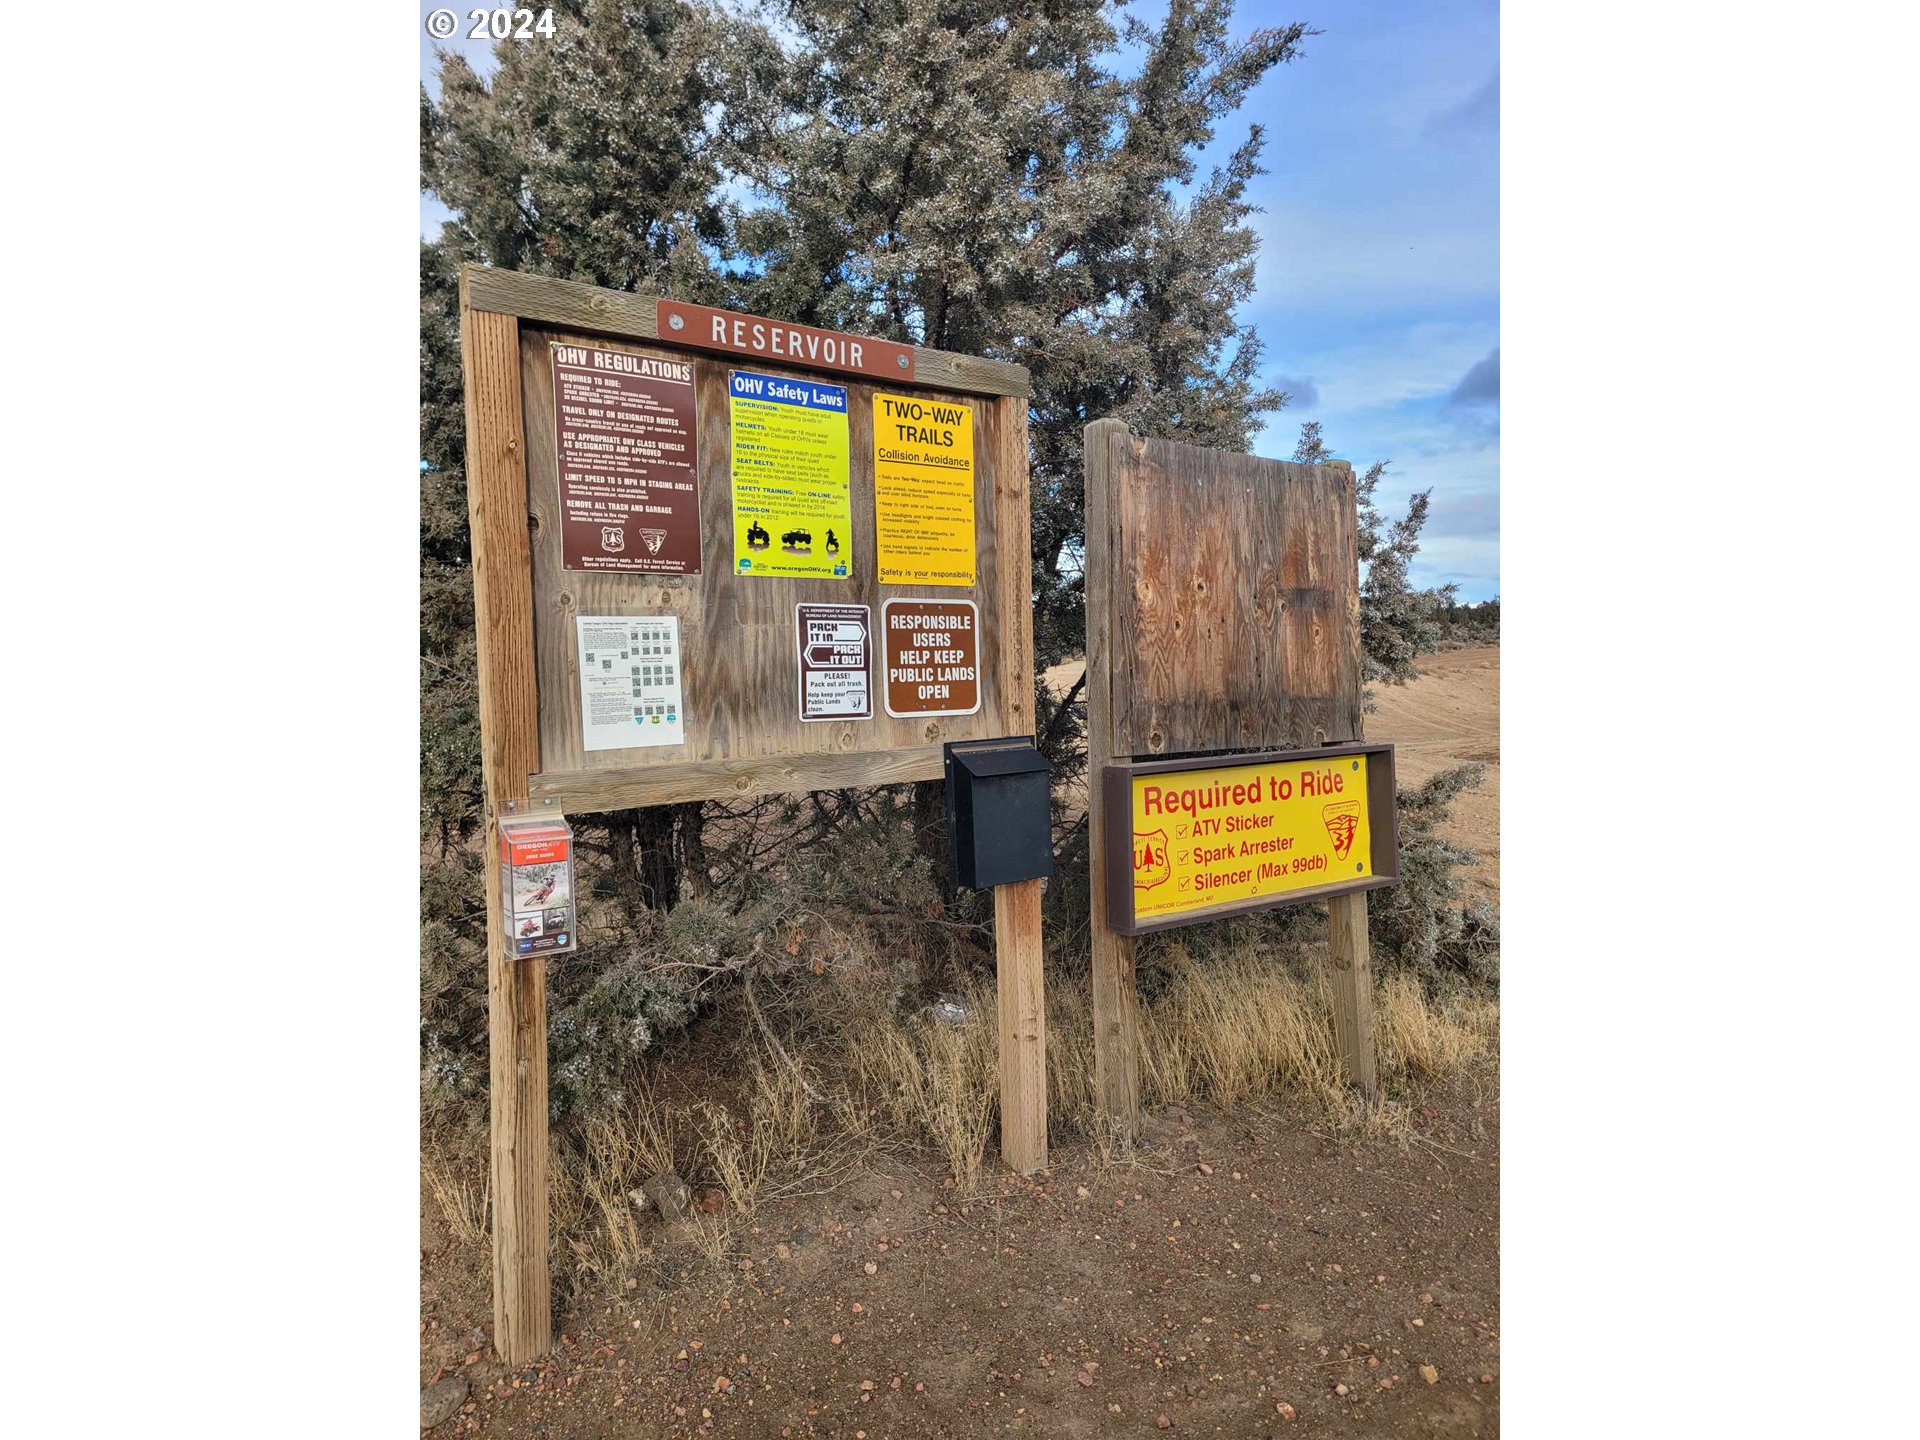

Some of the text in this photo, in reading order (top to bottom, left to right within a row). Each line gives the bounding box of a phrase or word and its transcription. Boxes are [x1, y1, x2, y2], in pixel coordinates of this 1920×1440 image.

[711, 315, 863, 368] RESERVOIR
[558, 347, 690, 381] OHV REGULATIONS
[560, 373, 591, 383] REQUIRED
[605, 379, 621, 387] RIDE:
[735, 377, 842, 407] OHV Safety Laws
[735, 401, 779, 411] SUPERVISION:
[883, 400, 963, 426] TWO-WAY
[562, 406, 586, 415] TRAVEL
[618, 412, 654, 423] DESIGNATED
[656, 417, 679, 426] ROUTES
[578, 433, 620, 444] APPROPRIATE
[637, 440, 656, 448] CLASS
[658, 442, 685, 451] VEHICLES
[896, 424, 953, 447] TRAILS
[575, 442, 614, 451] DESIGNATED
[631, 447, 661, 457] APPROVED
[879, 448, 970, 467] Collision Avoidance
[585, 475, 605, 483] SPEED
[648, 480, 673, 489] STAGING
[675, 482, 693, 491] AREAS
[567, 500, 592, 508] REMOVE
[608, 503, 628, 511] TRASH
[646, 506, 672, 514] GARBAGE
[881, 568, 903, 576] Safety
[931, 570, 972, 579] responsibility
[891, 615, 970, 629] RESPONSIBLE
[913, 633, 950, 647] USERS
[834, 646, 860, 654] PACK
[901, 650, 964, 664] HELP KEEP
[830, 656, 861, 664] IT OUT
[891, 667, 974, 682] PUBLIC LANDS
[918, 684, 949, 699] OPEN
[1144, 768, 1344, 818] Required to Ride
[1192, 814, 1274, 837] ATV Sticker
[1194, 836, 1294, 866] Spark Arrester
[1195, 854, 1328, 892] Silencer (Max 99db)
